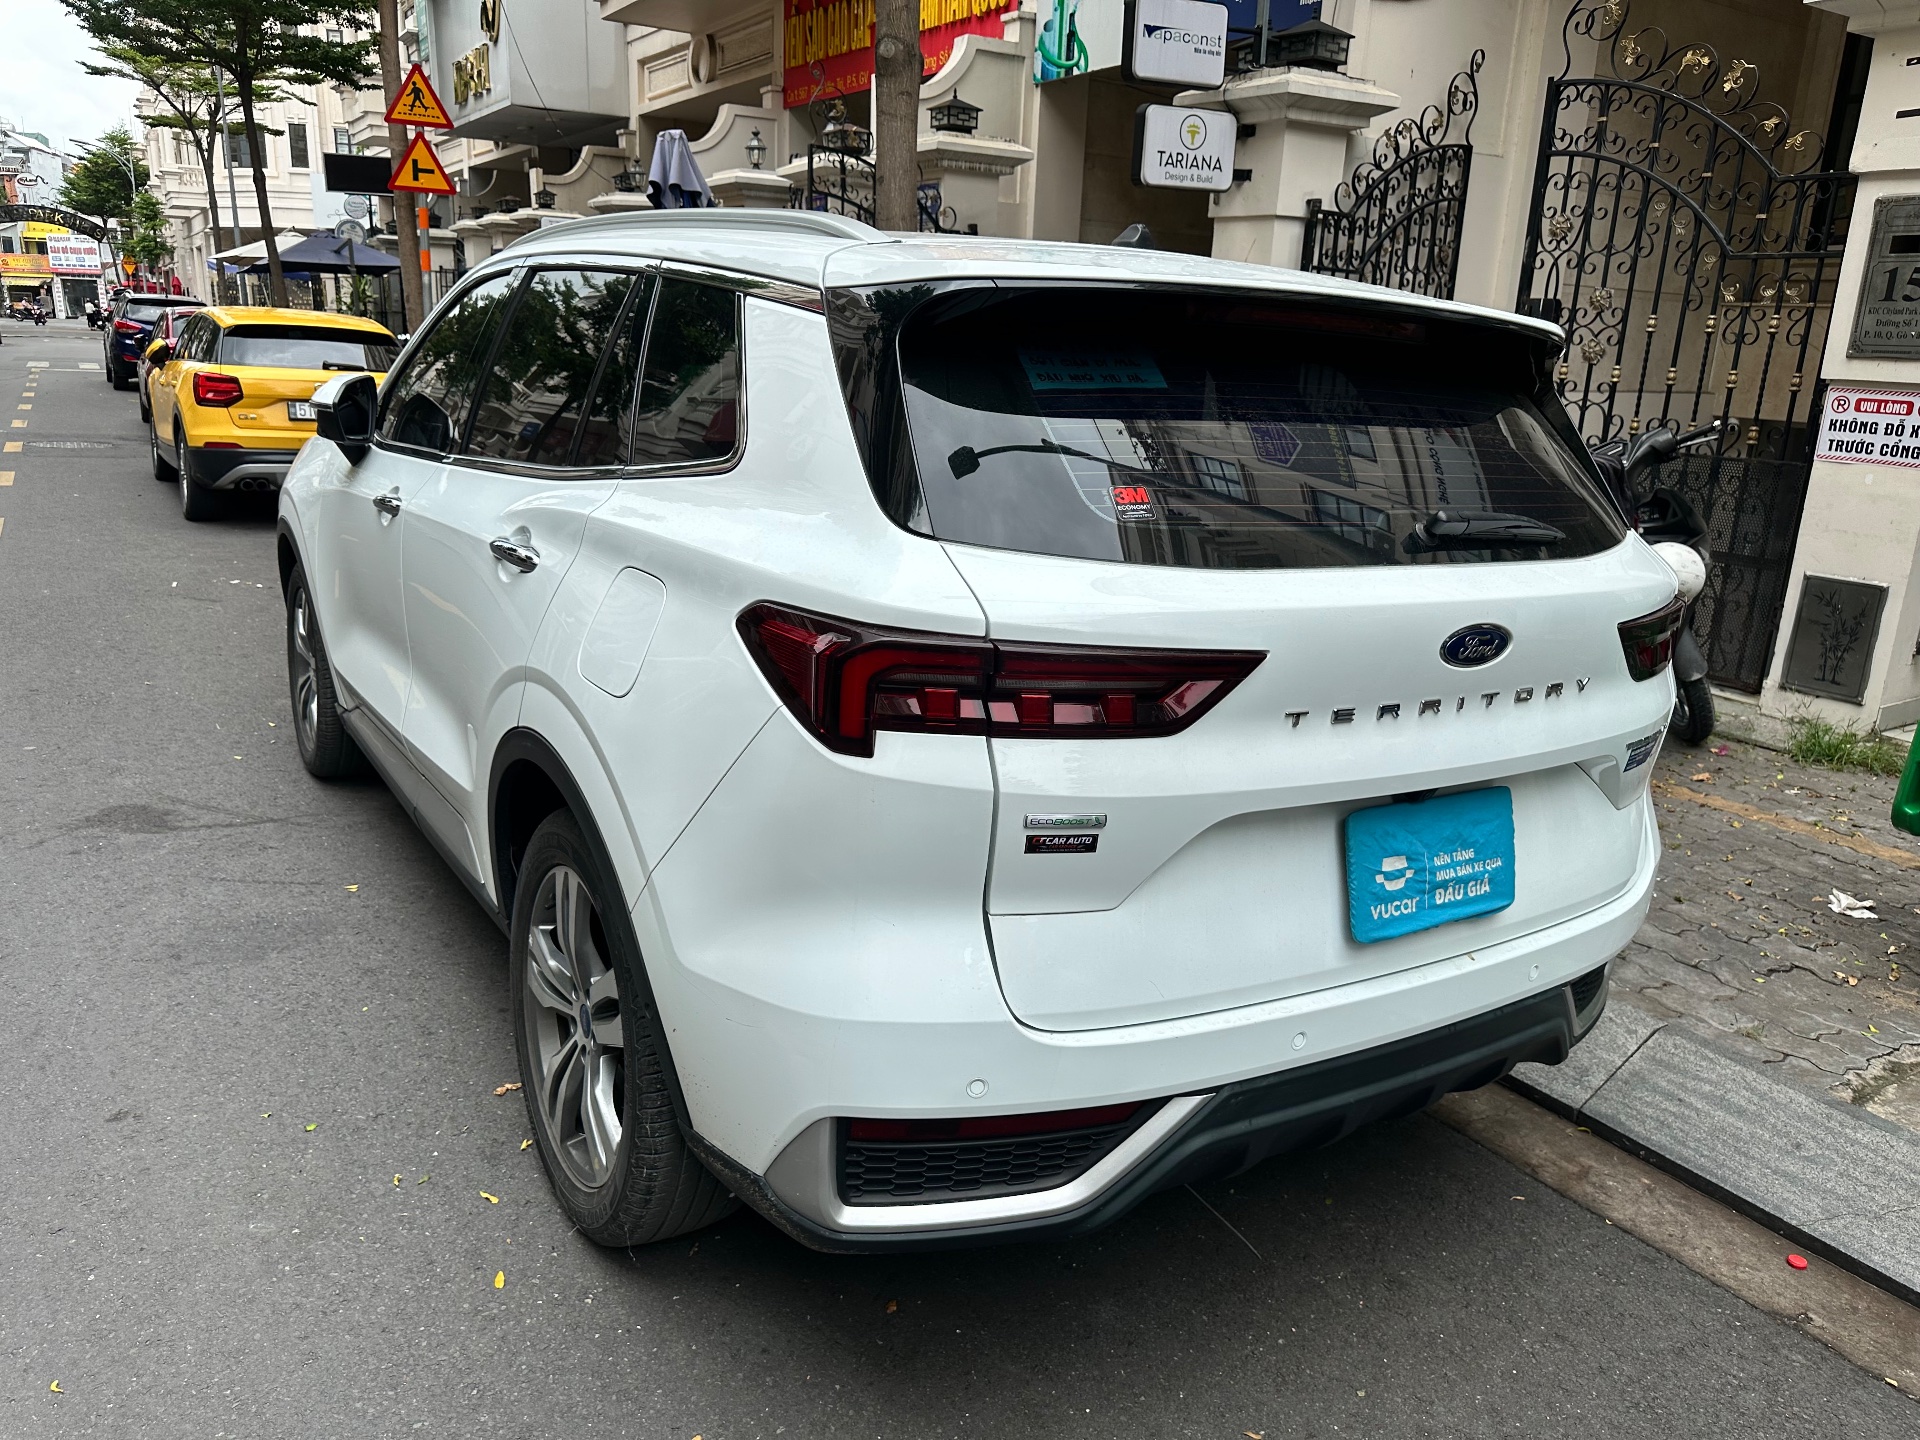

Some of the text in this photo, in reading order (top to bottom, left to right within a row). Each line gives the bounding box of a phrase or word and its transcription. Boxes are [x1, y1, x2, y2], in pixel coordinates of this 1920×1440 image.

[828, 2, 848, 57] CAO
[1157, 150, 1223, 173] TARIANA
[1164, 171, 1213, 184] Design & Build
[28, 208, 64, 224] PARK
[1864, 330, 1871, 339] P.
[1885, 330, 1895, 340] Q.
[1896, 331, 1908, 339] Gò
[1860, 400, 1907, 414] VUI LÒNG
[1828, 417, 1920, 439] KHÔNG ĐỖ X
[1828, 438, 1920, 460] TRƯỚC CỔNG
[1113, 487, 1149, 504] 3M
[1458, 635, 1499, 660] Ford
[1285, 676, 1591, 728] TERRITORY
[1030, 818, 1092, 826] ECOBOOST
[1067, 836, 1093, 845] AUTO
[1434, 852, 1451, 866] NỀN
[1436, 857, 1502, 881] MUA BÁN XE QUA
[1435, 873, 1490, 905] ĐẤU GIÁ
[1371, 896, 1420, 920] vucar
